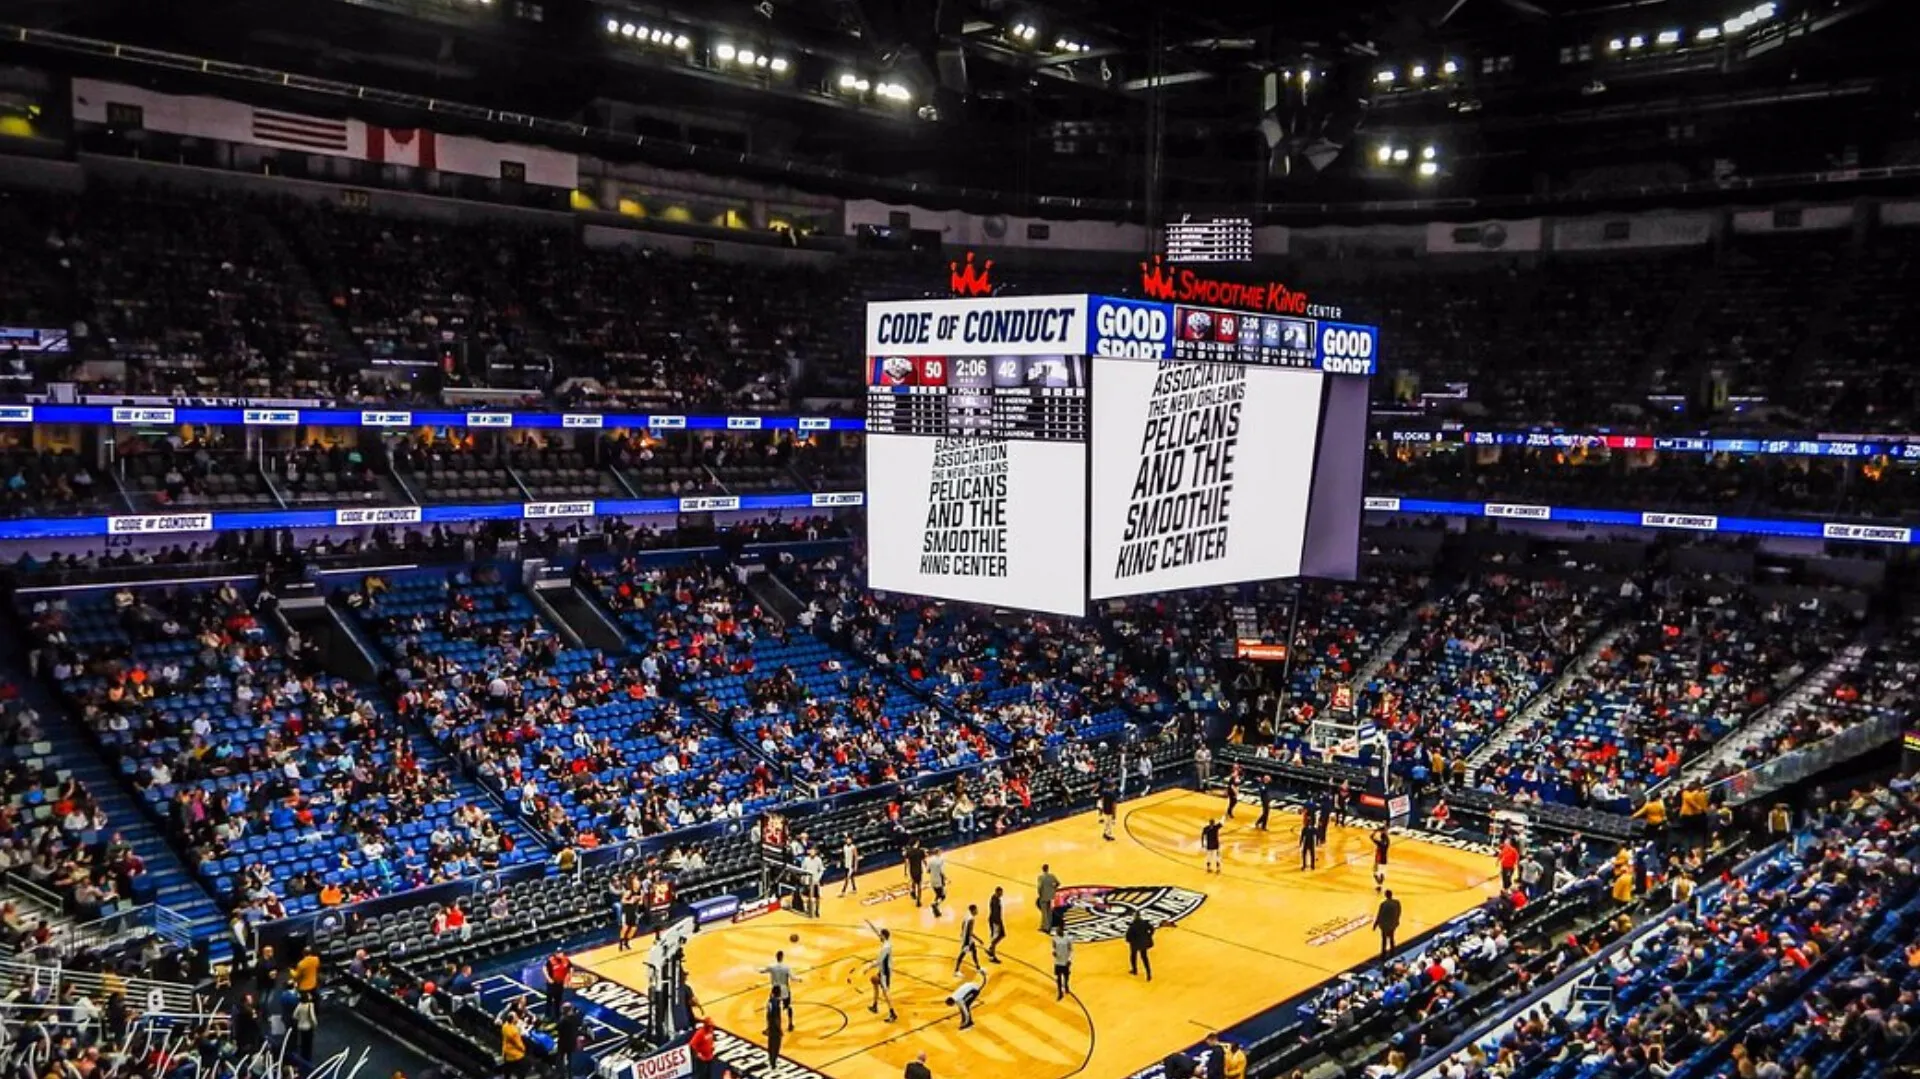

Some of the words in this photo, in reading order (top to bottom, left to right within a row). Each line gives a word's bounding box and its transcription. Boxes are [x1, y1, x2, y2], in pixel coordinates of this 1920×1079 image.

[1179, 270, 1265, 307] SMOOTHIE
[1307, 304, 1342, 318] CENTER
[877, 312, 932, 344] CODE
[937, 316, 959, 340] OF
[963, 308, 1075, 343] CONDUCT
[1097, 304, 1167, 340] GOOD
[1220, 318, 1234, 335] 50
[1323, 327, 1372, 358] GOOD
[925, 361, 942, 378] 50
[956, 359, 987, 376] 2:06
[998, 361, 1016, 378] 42
[1148, 399, 1168, 418] THE
[1168, 392, 1196, 413] NEW
[1197, 382, 1246, 407] ORLEANS
[1141, 402, 1241, 455] PELICANS
[1393, 432, 1431, 441] BLOCKS
[932, 444, 1007, 468] ASSOCIATION
[968, 461, 1008, 477] ORLEANS
[1131, 449, 1186, 500] AND
[1192, 438, 1237, 488] THE
[929, 474, 1007, 502] PELICANS
[341, 511, 364, 522] CODE
[366, 511, 375, 520] OF
[376, 510, 417, 521] CONDUCT
[528, 504, 547, 516] CODE
[557, 504, 592, 515] CONDUCT
[926, 502, 964, 529] AND
[969, 499, 1007, 527] THE
[1123, 484, 1233, 542] SMOOTHIE
[1514, 507, 1546, 517] CONDUCT
[1646, 514, 1666, 525] CODE
[1675, 516, 1714, 528] CONDUCT
[115, 518, 142, 531] CODE
[145, 519, 156, 528] OF
[158, 516, 207, 530] CONDUCT
[1827, 526, 1850, 537] CODE
[1852, 527, 1861, 536] OF
[1863, 528, 1906, 540] CONDUCT
[923, 528, 1007, 553] SMOOTHIE
[1115, 539, 1159, 579] KING
[1161, 526, 1228, 569] CENTER
[920, 555, 950, 575] KING
[953, 555, 1007, 577] CENTER
[637, 1048, 686, 1079] ROUSES
